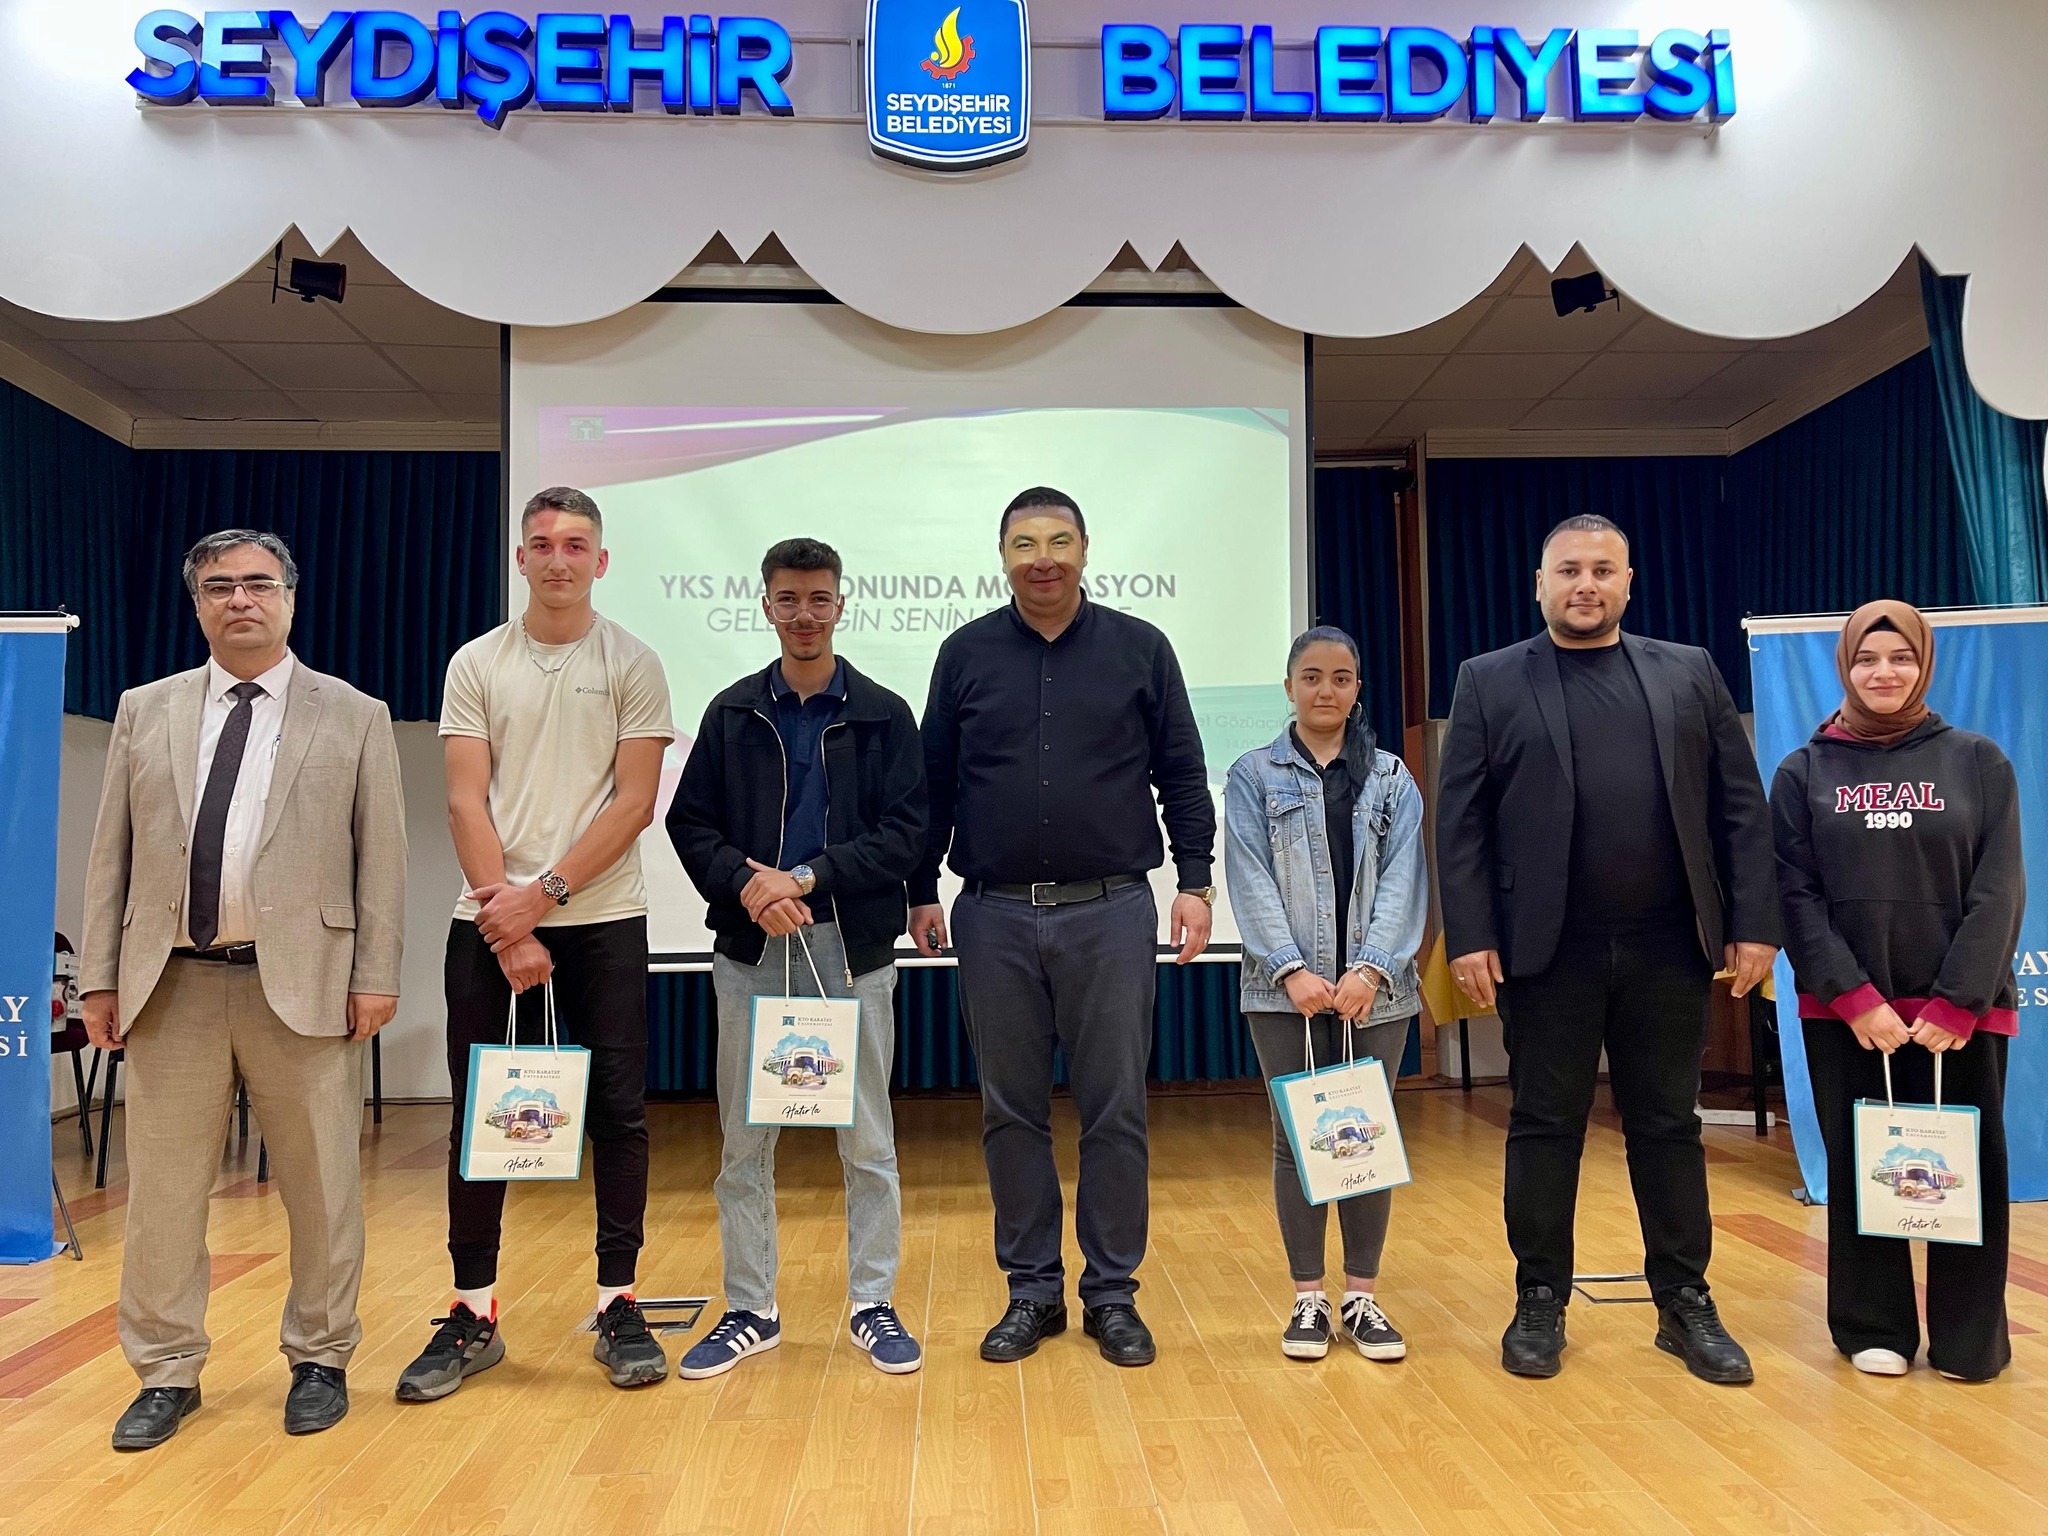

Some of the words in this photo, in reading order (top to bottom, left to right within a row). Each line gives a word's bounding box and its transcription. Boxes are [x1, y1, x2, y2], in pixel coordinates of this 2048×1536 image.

[125, 9, 794, 129] SEYDİŞEHİR
[1102, 24, 1736, 123] BELEDİYESİ
[886, 93, 1010, 115] SEYDİŞEHİR
[887, 115, 1012, 134] BELEDİYESİ
[659, 575, 713, 599] YKS
[724, 575, 967, 599] MAONUNDA
[1835, 782, 1944, 813] MEAL
[1864, 812, 1913, 829] 1990
